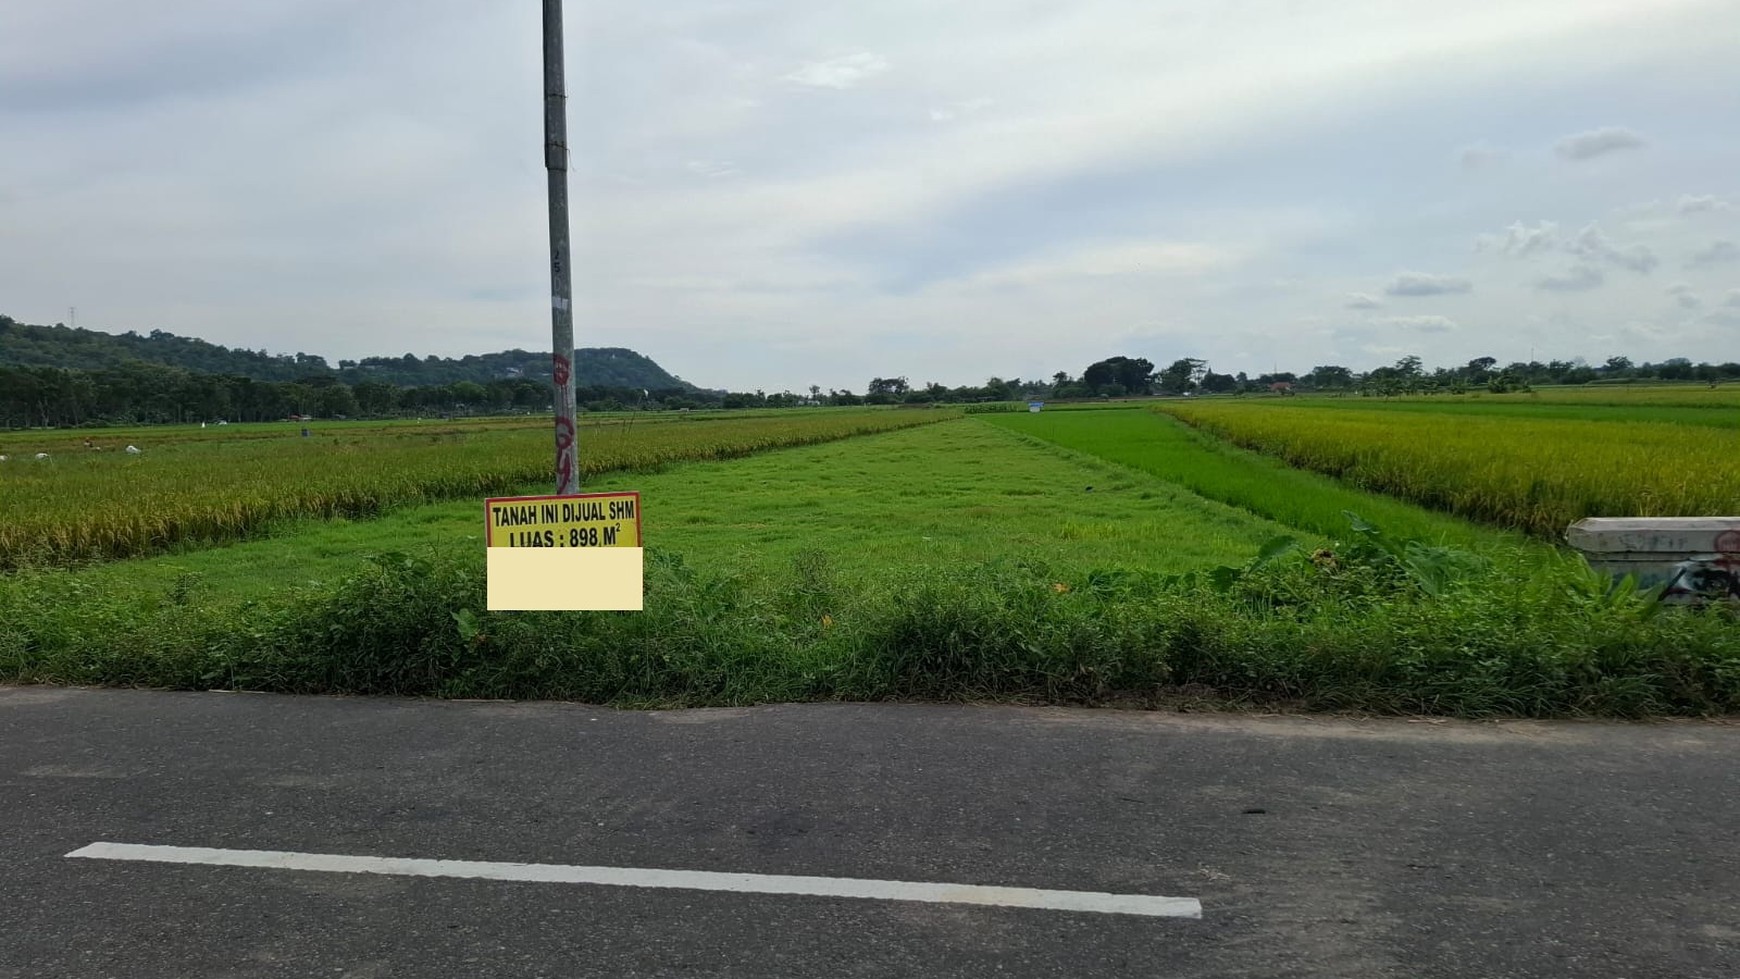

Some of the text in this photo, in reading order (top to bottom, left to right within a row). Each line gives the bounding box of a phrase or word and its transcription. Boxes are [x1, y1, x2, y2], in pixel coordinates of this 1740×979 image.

[493, 501, 634, 526] TANAH INI DIJUAL SHM
